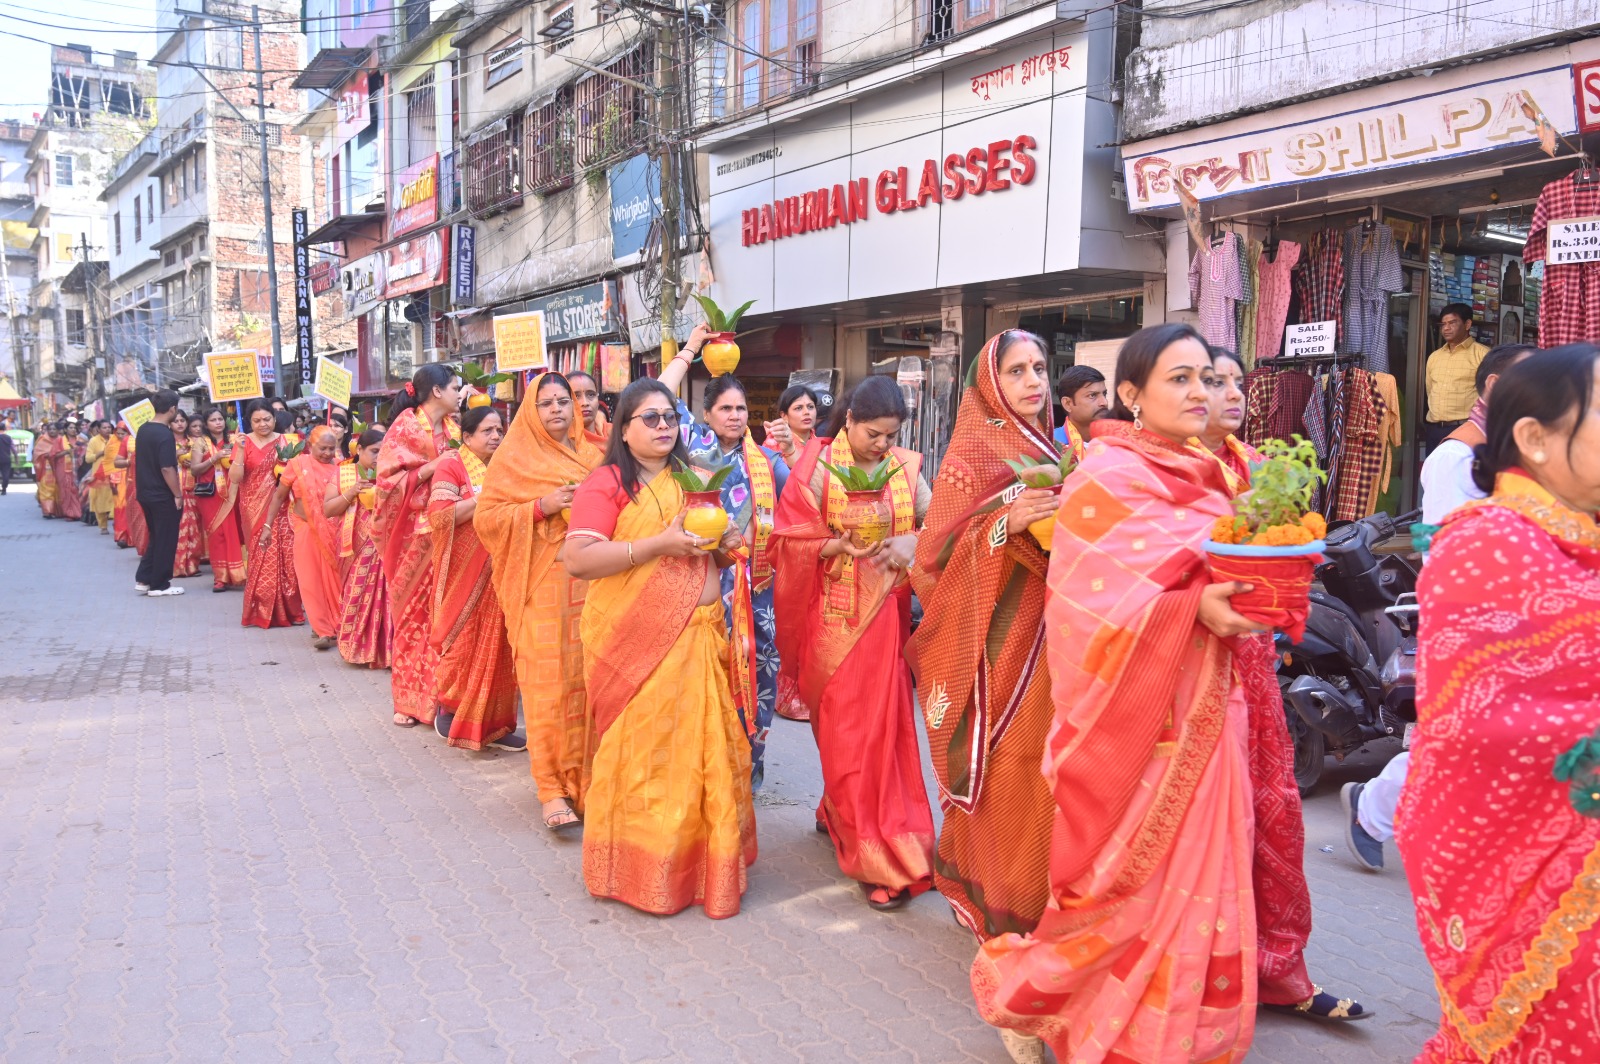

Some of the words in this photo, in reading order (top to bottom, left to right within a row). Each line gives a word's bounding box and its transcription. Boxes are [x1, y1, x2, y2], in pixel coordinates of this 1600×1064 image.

[970, 63, 1016, 101] হনুমান
[1285, 89, 1540, 177] SHILPA
[742, 177, 869, 247] HANUMAN
[875, 134, 1037, 215] GLASSES
[1133, 147, 1272, 203] শিল্পা
[613, 194, 650, 228] Whirlpool
[1564, 222, 1600, 233] SALE
[460, 226, 472, 298] RAJESH
[1290, 334, 1330, 344] Rs.250/-
[1298, 324, 1324, 333] SALE
[1295, 345, 1325, 354] FIXED
